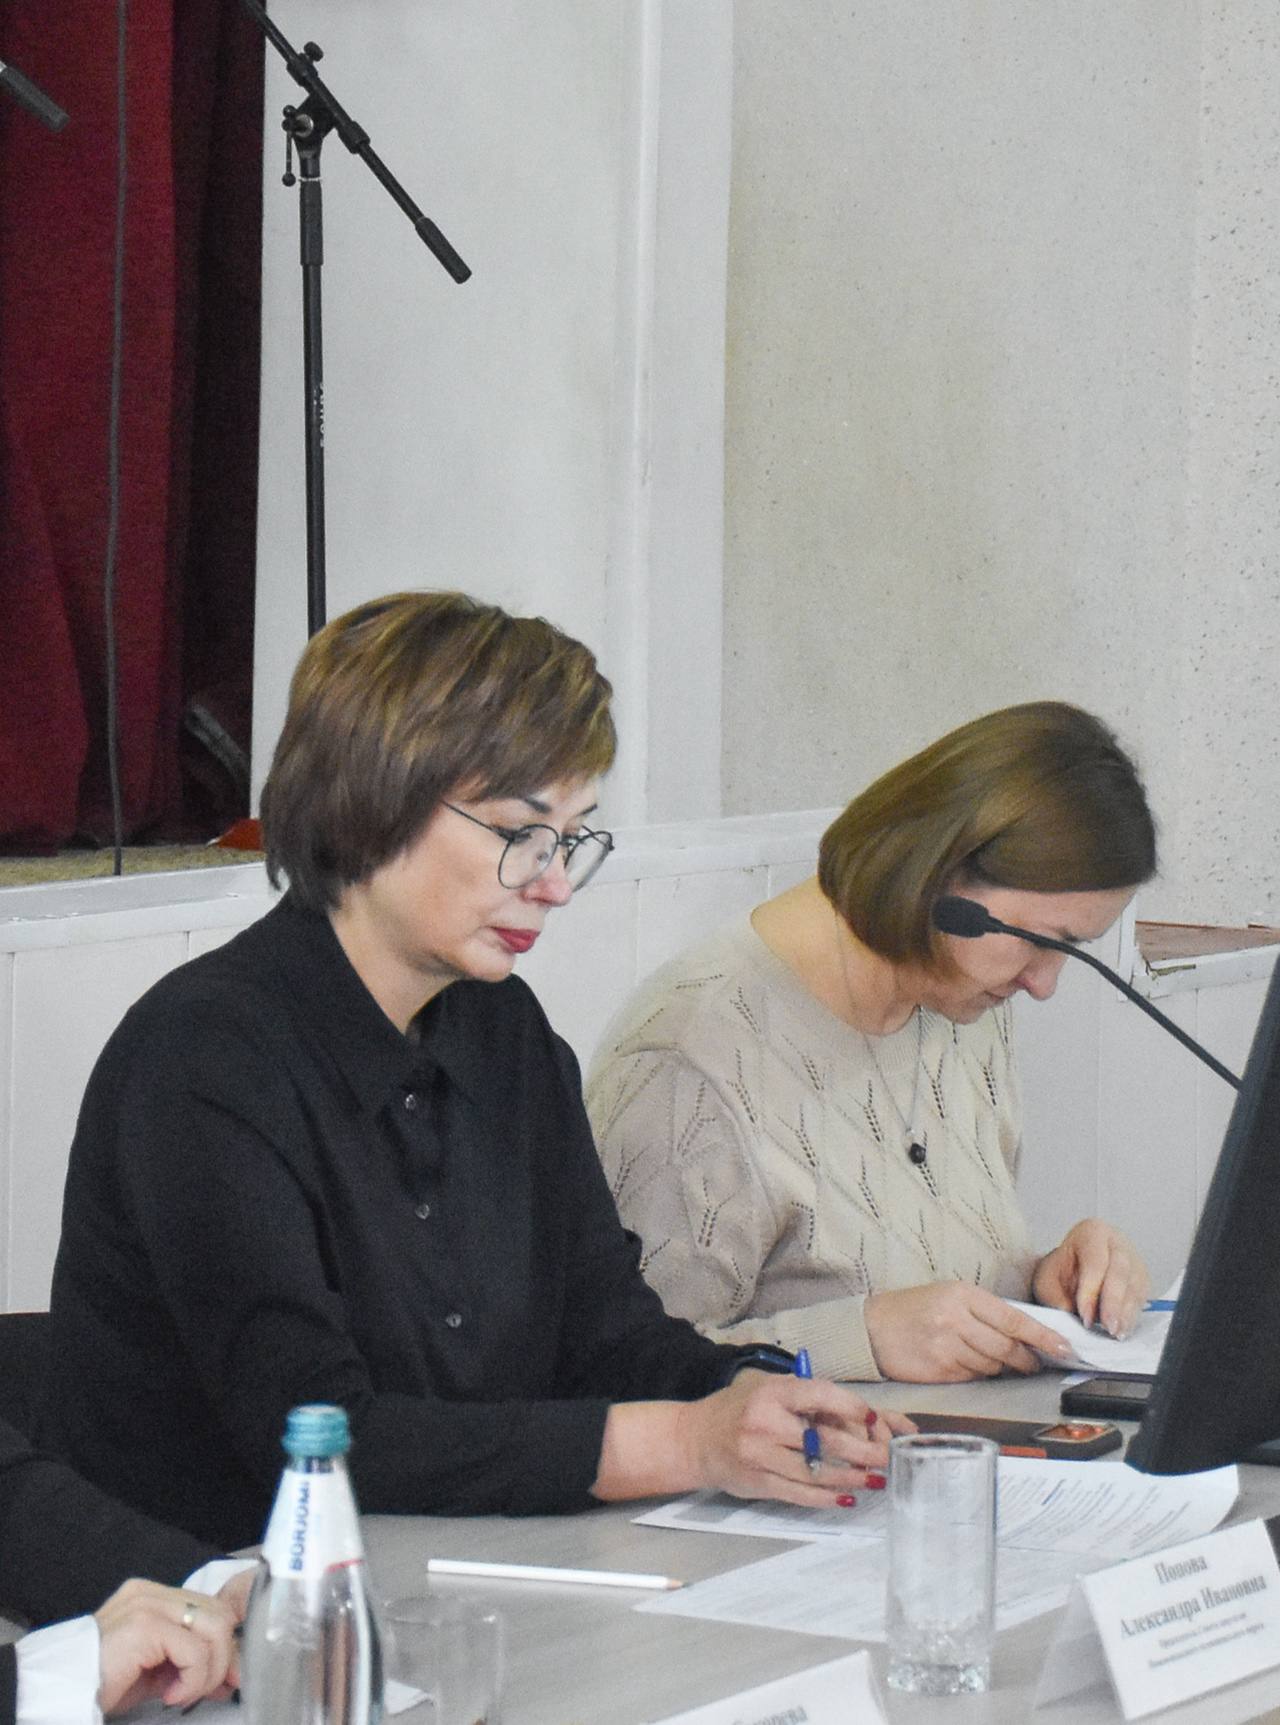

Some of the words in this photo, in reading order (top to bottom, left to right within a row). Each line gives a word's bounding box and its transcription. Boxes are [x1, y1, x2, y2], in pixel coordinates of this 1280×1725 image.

[1153, 1555, 1208, 1585] Попова
[1120, 1598, 1202, 1640] Александра
[1200, 1575, 1267, 1610] Ивановна
